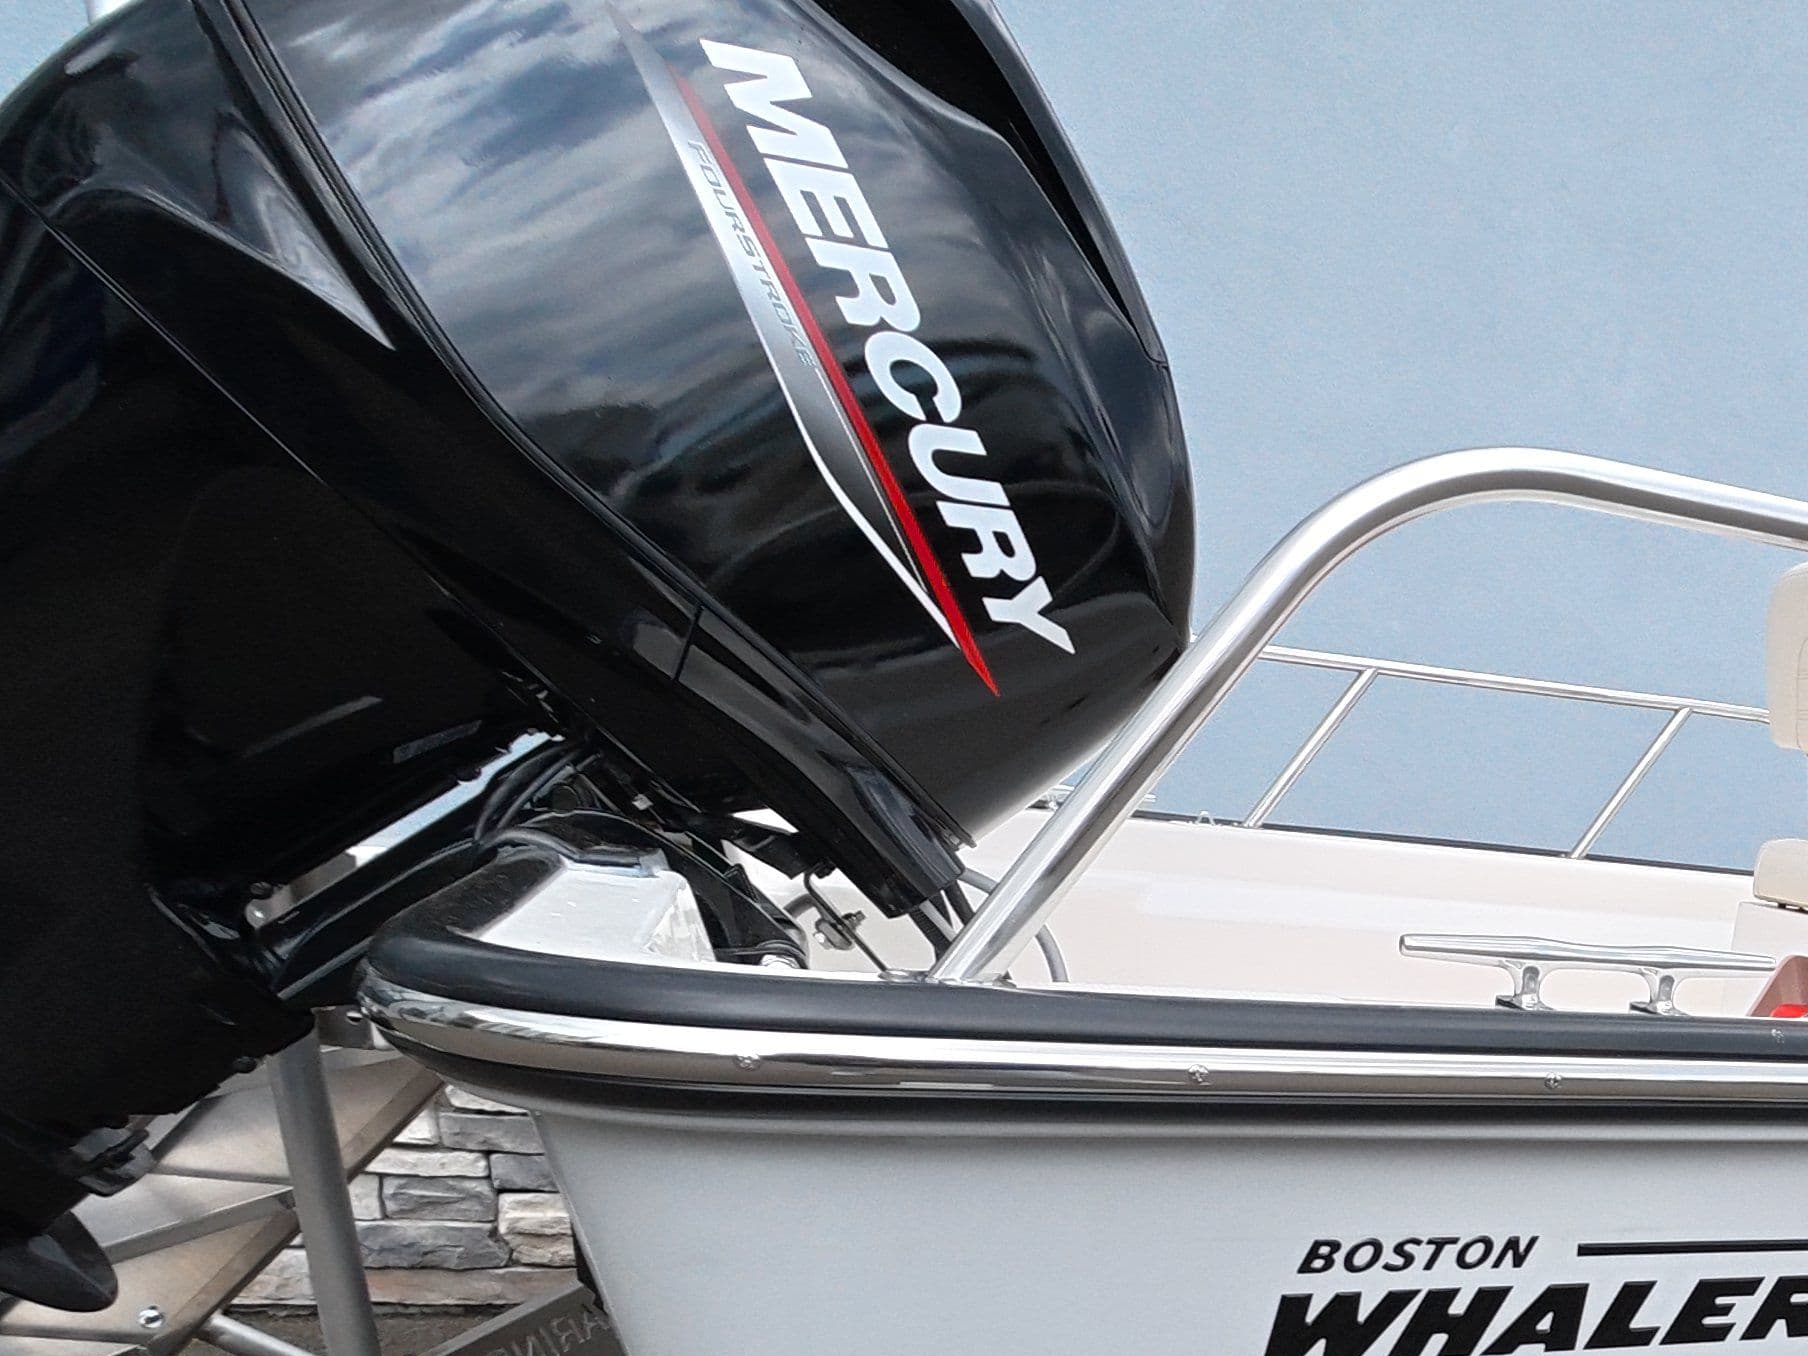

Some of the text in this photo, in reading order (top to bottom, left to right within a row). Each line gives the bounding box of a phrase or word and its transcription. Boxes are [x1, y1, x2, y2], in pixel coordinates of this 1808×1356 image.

[688, 139, 816, 367] FOURSTROKE
[699, 38, 1075, 655] MERCURY
[1296, 1235, 1540, 1275] BOSTON
